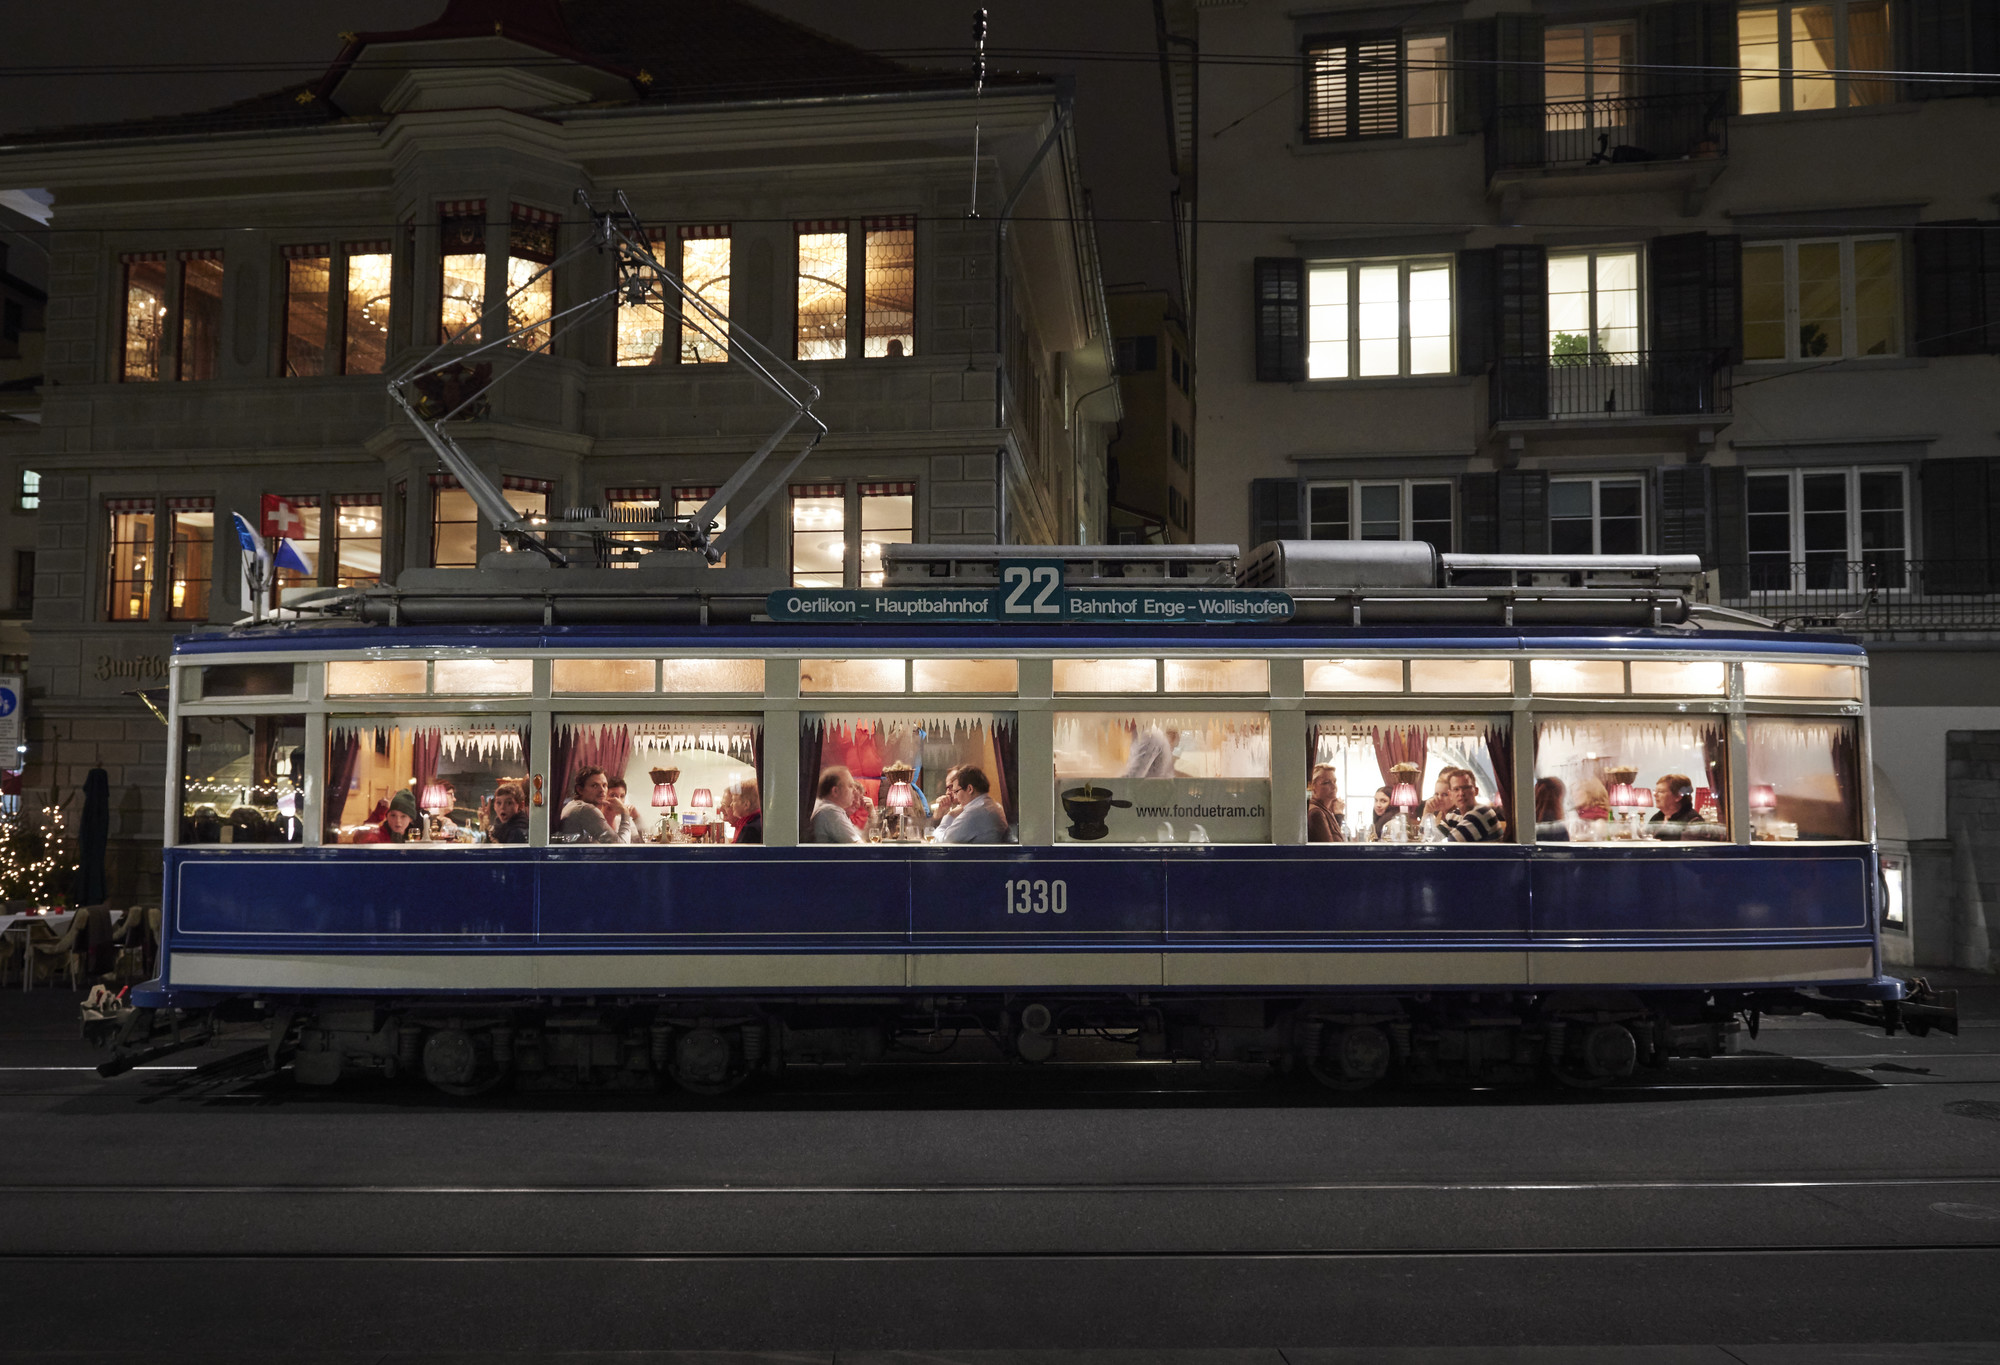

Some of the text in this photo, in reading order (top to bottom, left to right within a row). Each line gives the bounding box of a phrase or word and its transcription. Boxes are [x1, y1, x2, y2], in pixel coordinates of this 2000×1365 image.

[1004, 566, 1060, 614] 22
[786, 597, 856, 613] Oerlikon
[875, 597, 989, 616] Hauptbahnhof
[1070, 598, 1138, 614] Bahnhof
[1143, 598, 1186, 617] Enge
[1199, 598, 1289, 614] Wollishofen
[1136, 804, 1265, 818] www.fonduetram.ch
[1005, 879, 1067, 914] 1330
